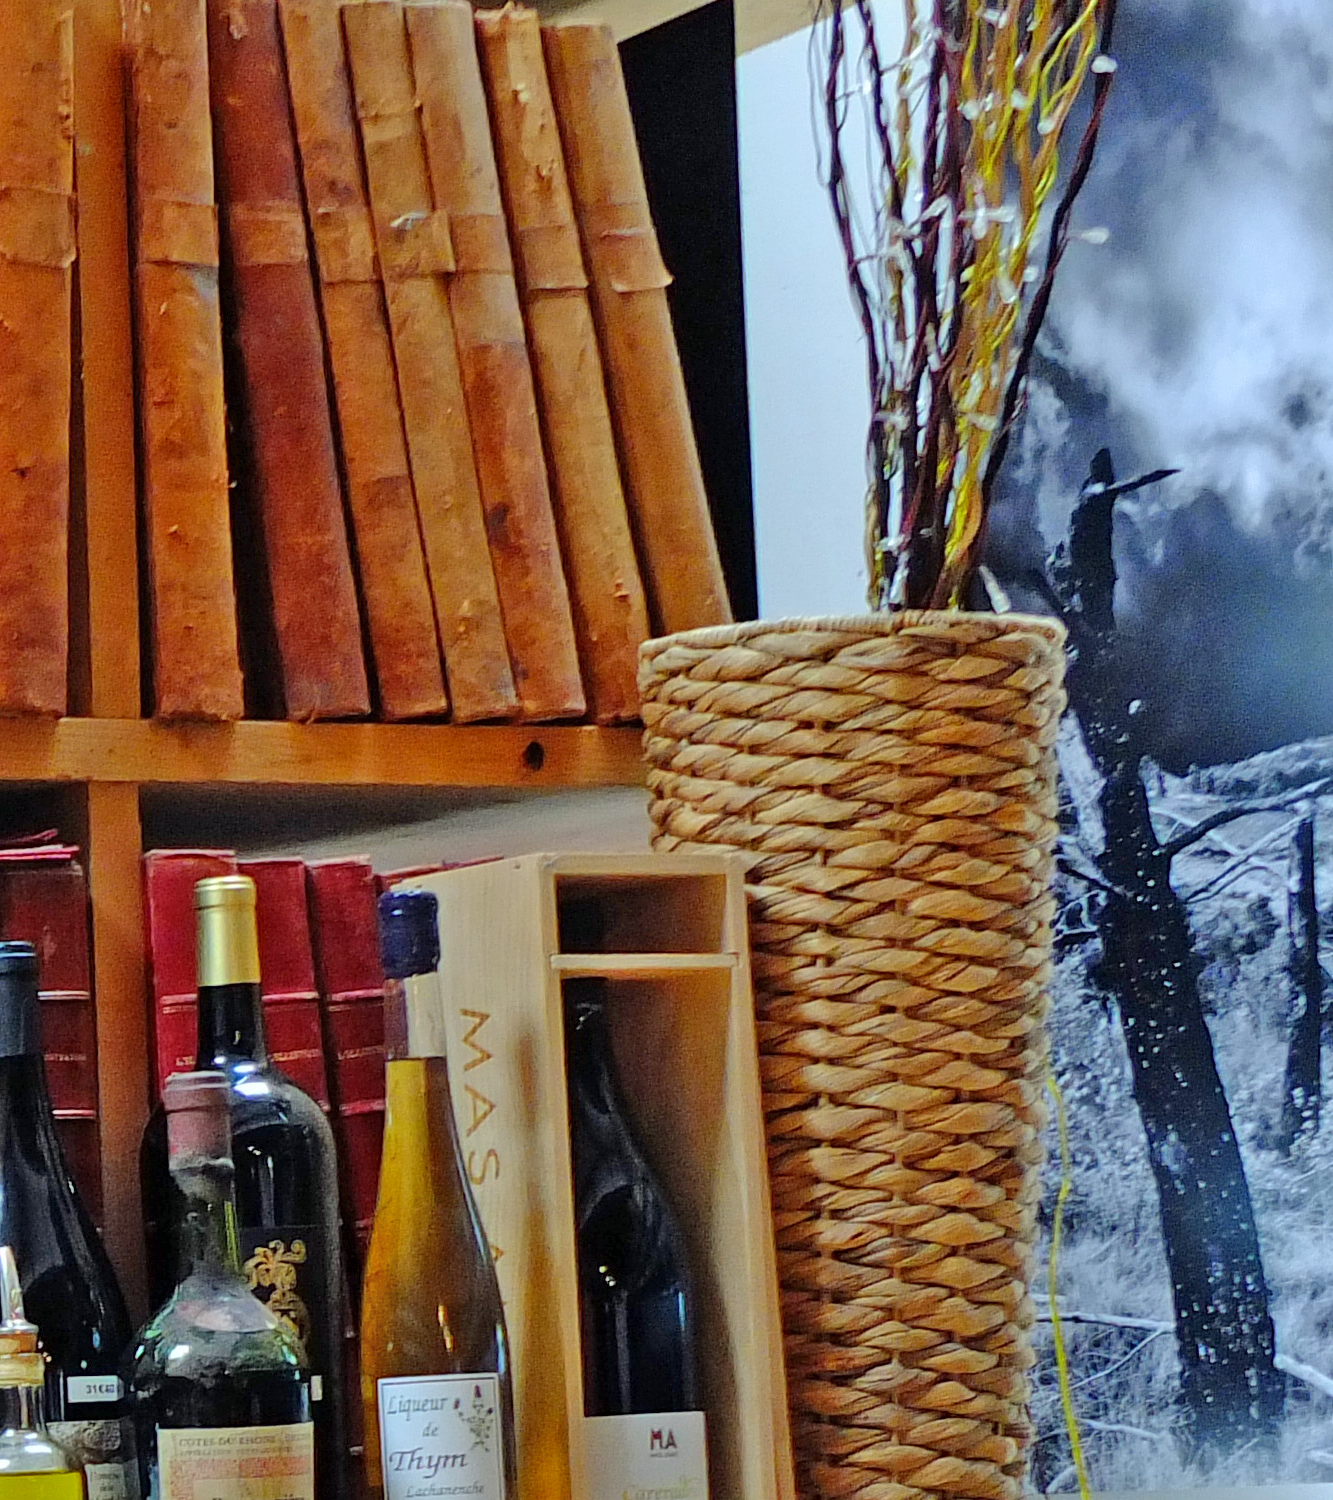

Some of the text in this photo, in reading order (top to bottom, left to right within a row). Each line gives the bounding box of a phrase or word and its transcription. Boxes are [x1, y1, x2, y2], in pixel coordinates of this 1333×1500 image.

[459, 1008, 501, 1186] MAS
[387, 1395, 448, 1421] Liqueur
[422, 1422, 440, 1438] de
[389, 1446, 468, 1480] Thym
